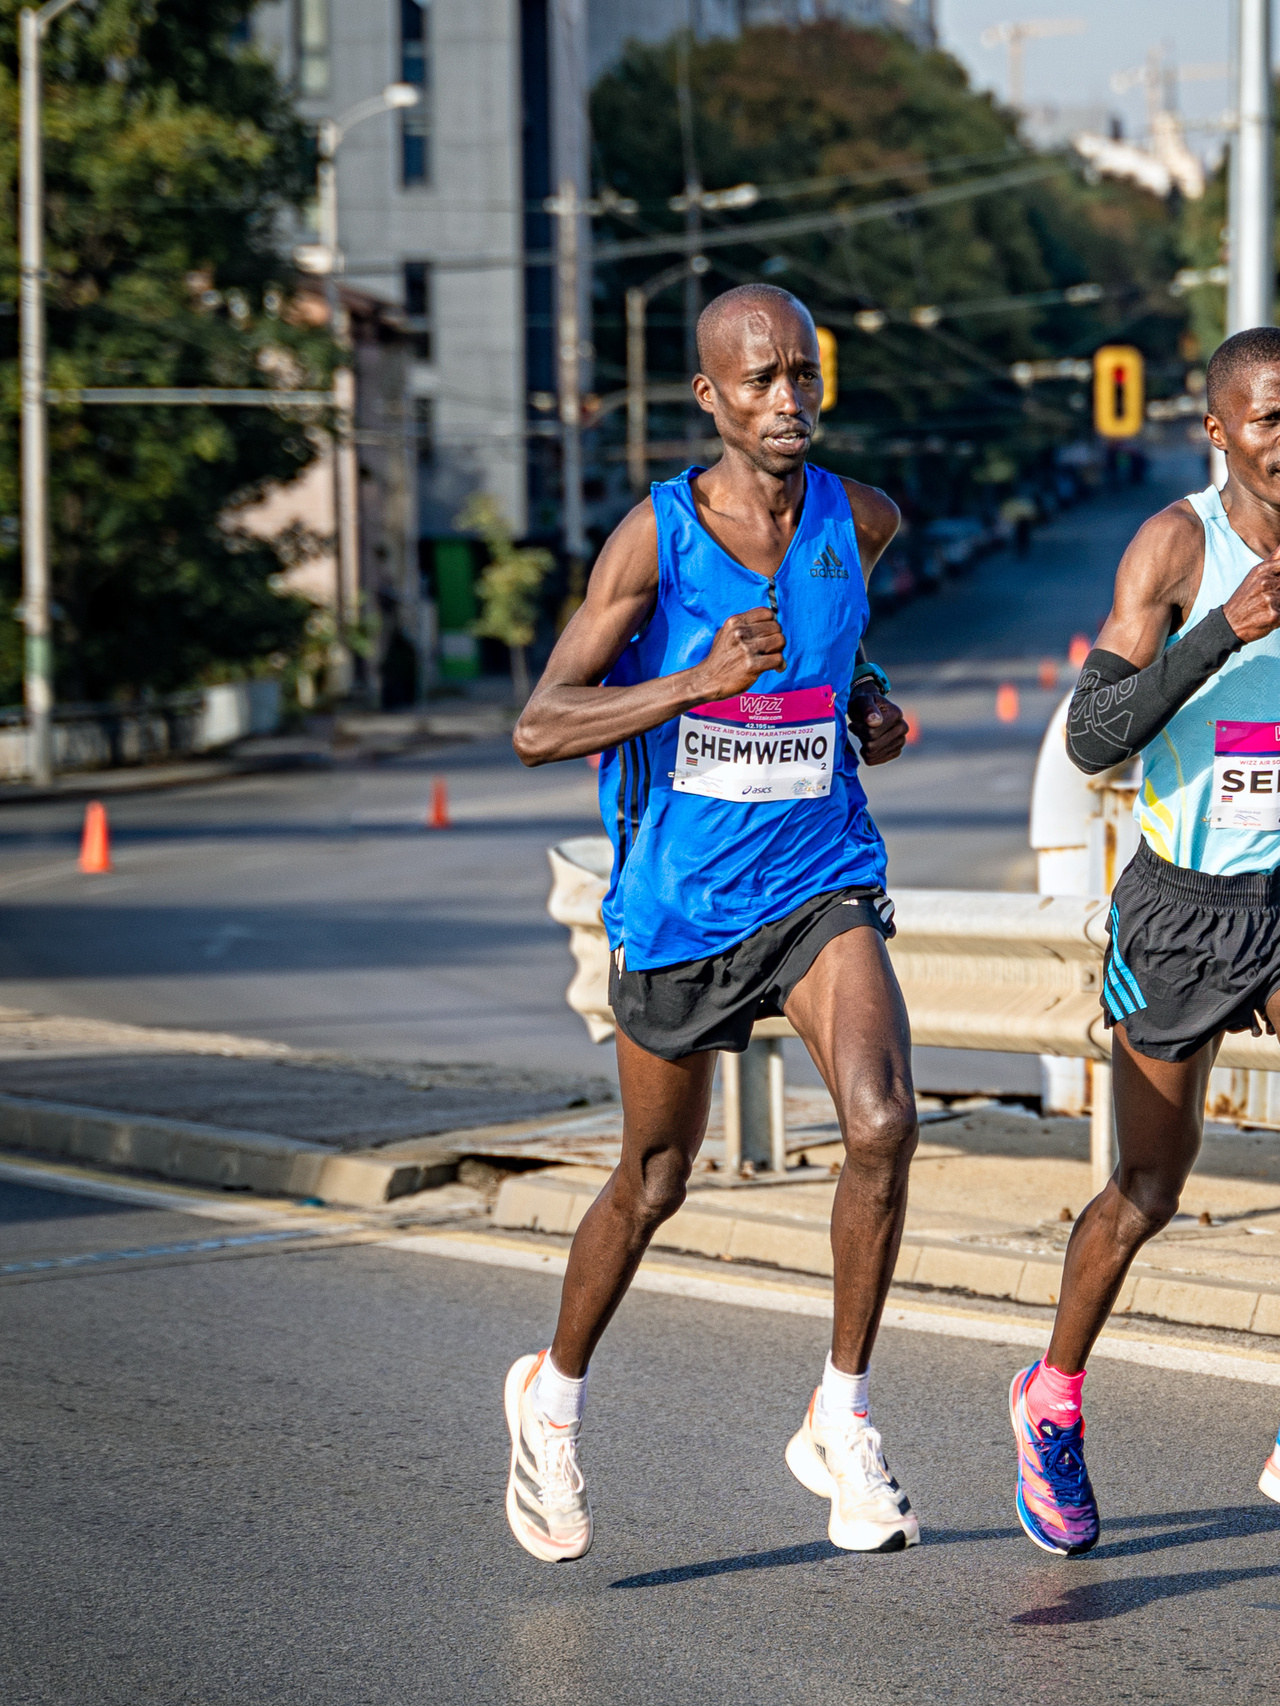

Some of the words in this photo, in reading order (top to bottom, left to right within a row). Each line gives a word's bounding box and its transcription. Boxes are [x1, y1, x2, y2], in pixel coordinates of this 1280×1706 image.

[703, 724, 721, 732] WIZZ
[684, 731, 828, 765] CHEMWENO
[820, 763, 827, 771] 2
